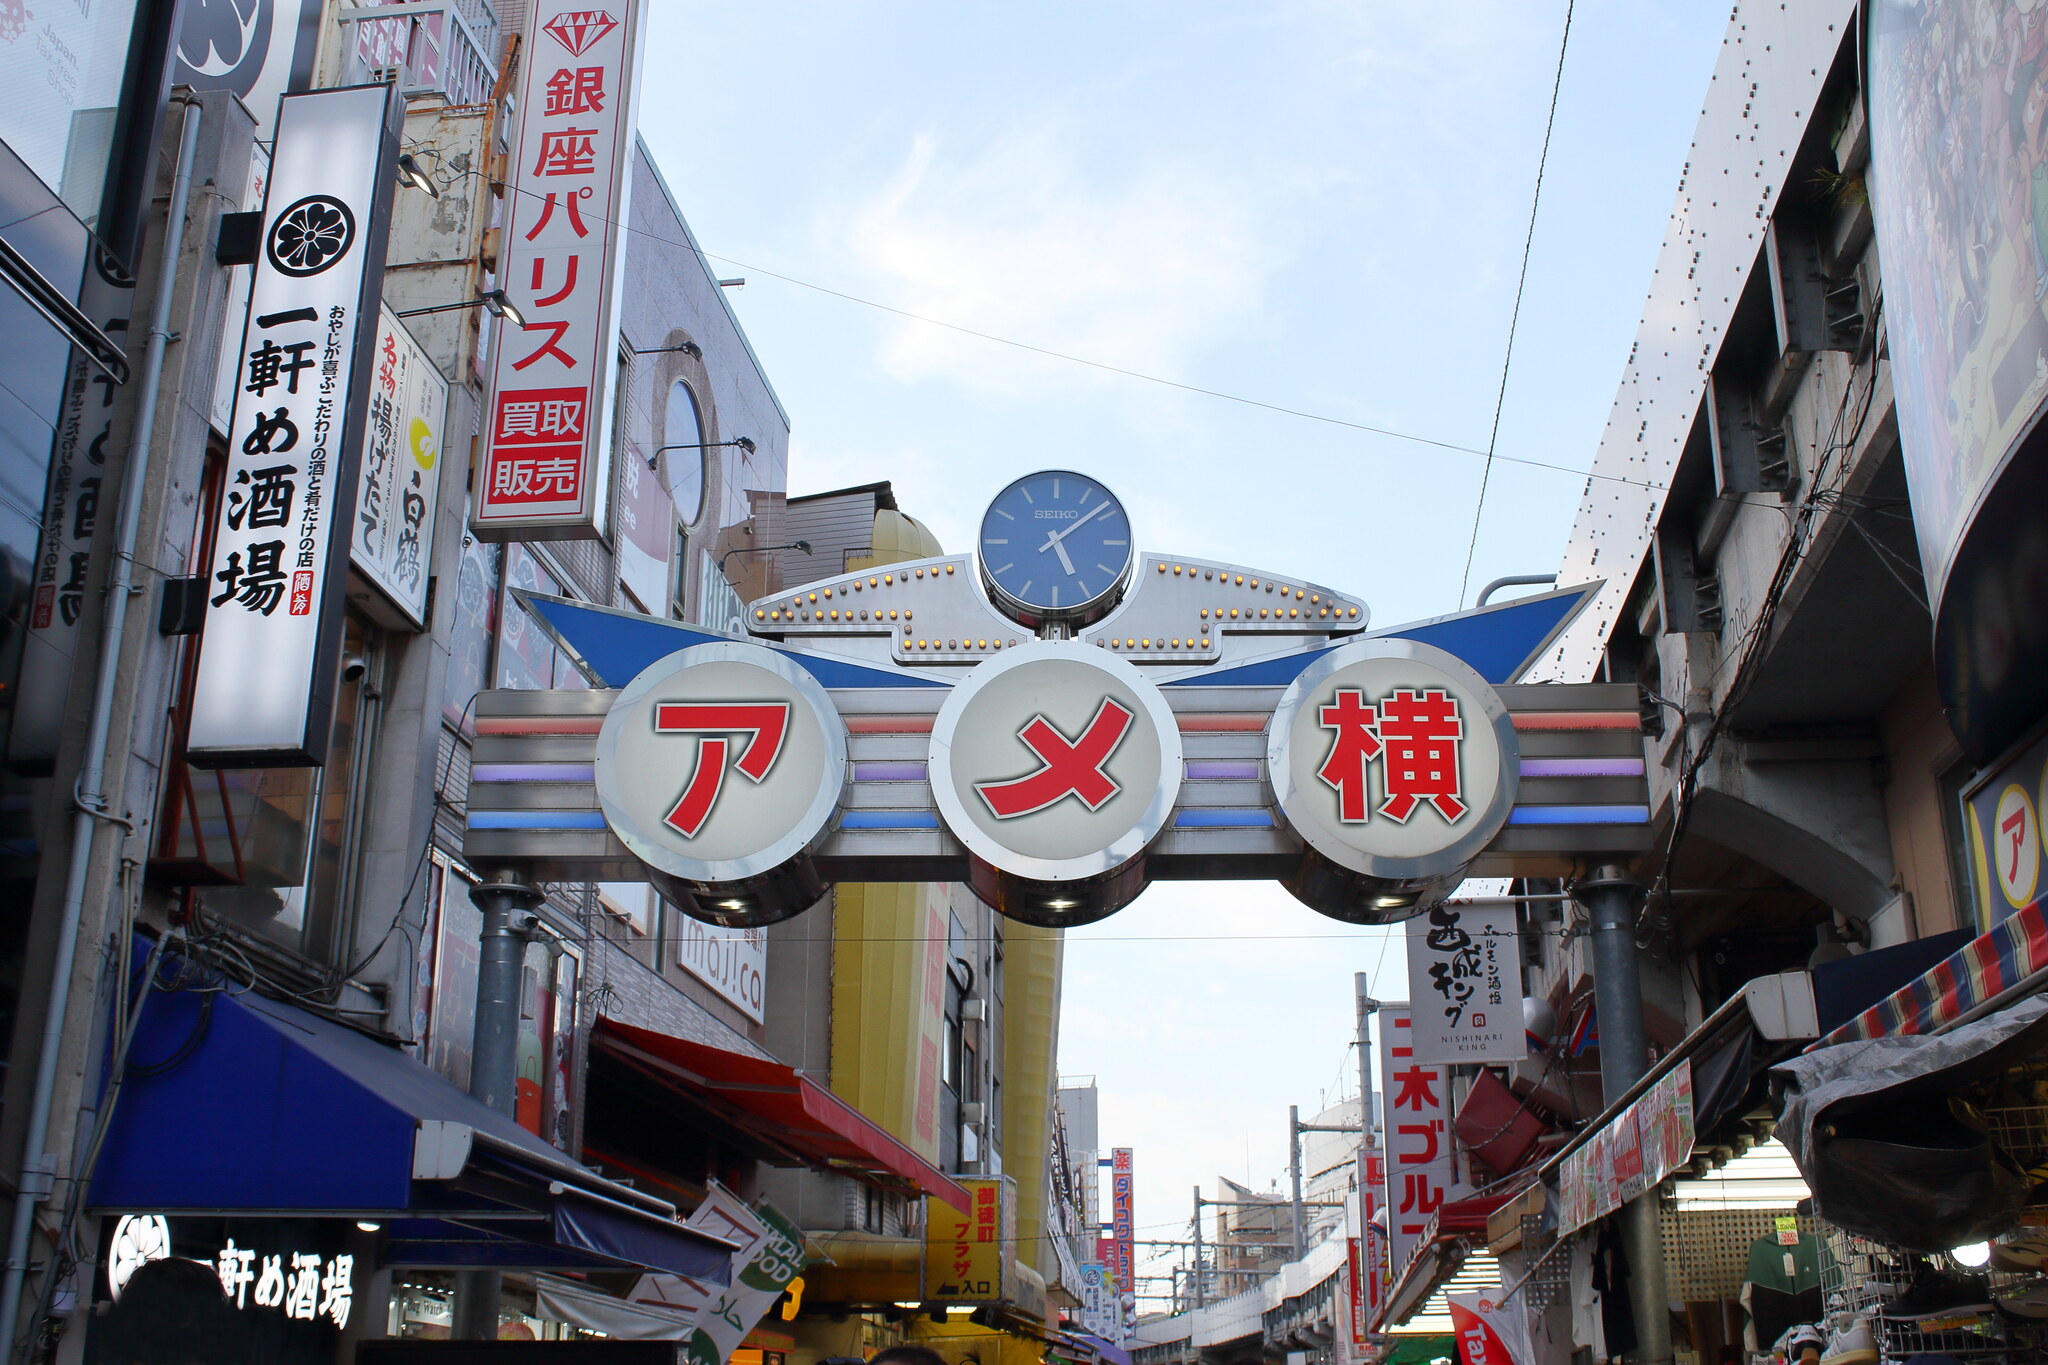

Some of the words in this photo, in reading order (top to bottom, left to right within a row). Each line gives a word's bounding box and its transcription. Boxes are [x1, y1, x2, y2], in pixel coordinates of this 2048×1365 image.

[35, 33, 77, 89] Tax-free
[47, 69, 74, 105] Shop
[512, 66, 605, 372] 銀座パリス
[500, 400, 582, 437] 買取
[211, 306, 319, 617] 一軒め酒場
[492, 457, 577, 498] 販売
[1034, 510, 1079, 519] SEIKO
[2002, 806, 2025, 885] ア
[1441, 1034, 1503, 1043] NISHINARI
[977, 1187, 995, 1243] 御徒町
[953, 1221, 972, 1279] プラザ
[962, 1280, 990, 1294] 入口
